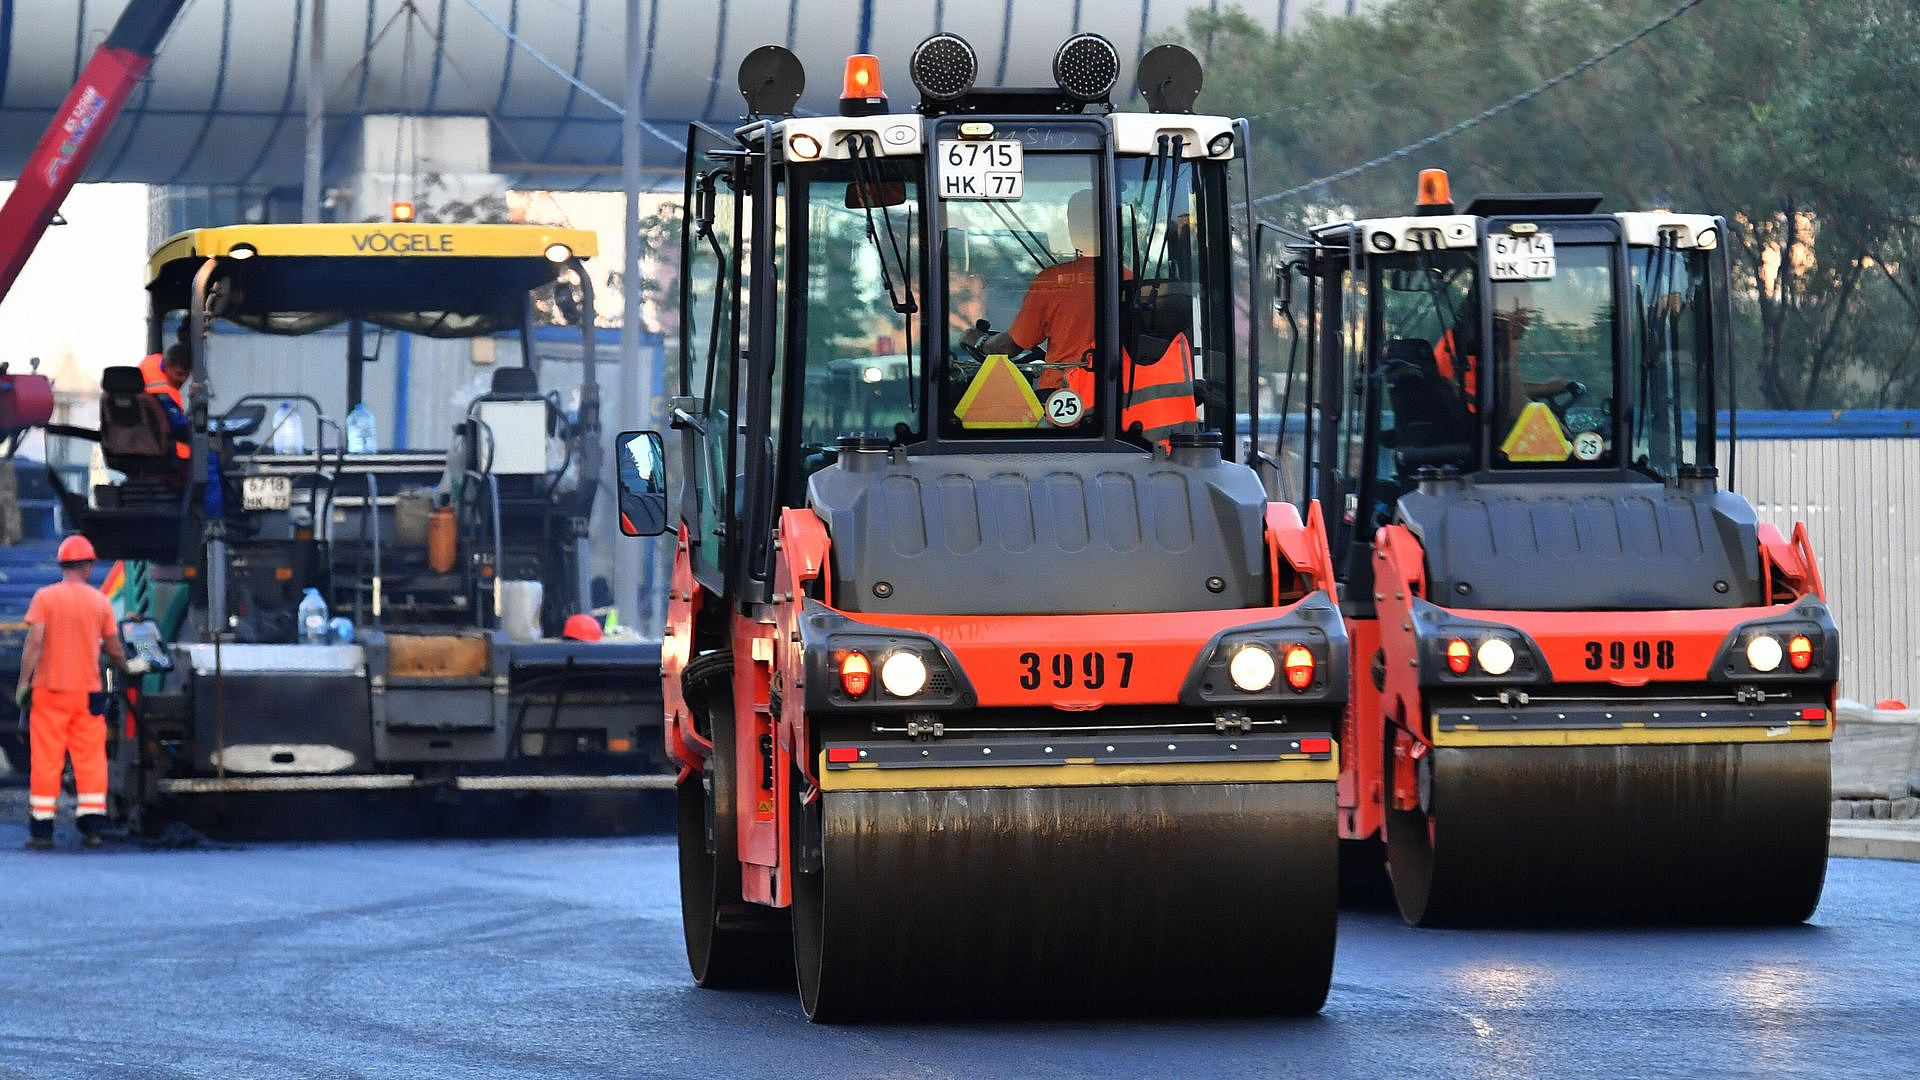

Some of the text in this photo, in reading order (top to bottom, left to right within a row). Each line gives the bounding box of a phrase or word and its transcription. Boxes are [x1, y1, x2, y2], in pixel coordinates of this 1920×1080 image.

[949, 144, 1012, 166] 6715
[992, 177, 1016, 194] 77
[351, 230, 455, 252] VÖGELE
[1496, 236, 1546, 254] 6714
[1530, 260, 1549, 275] 77
[1053, 397, 1078, 417] 25
[1581, 440, 1597, 455] 25
[1585, 640, 1674, 670] 3998
[1019, 652, 1134, 690] 3997
